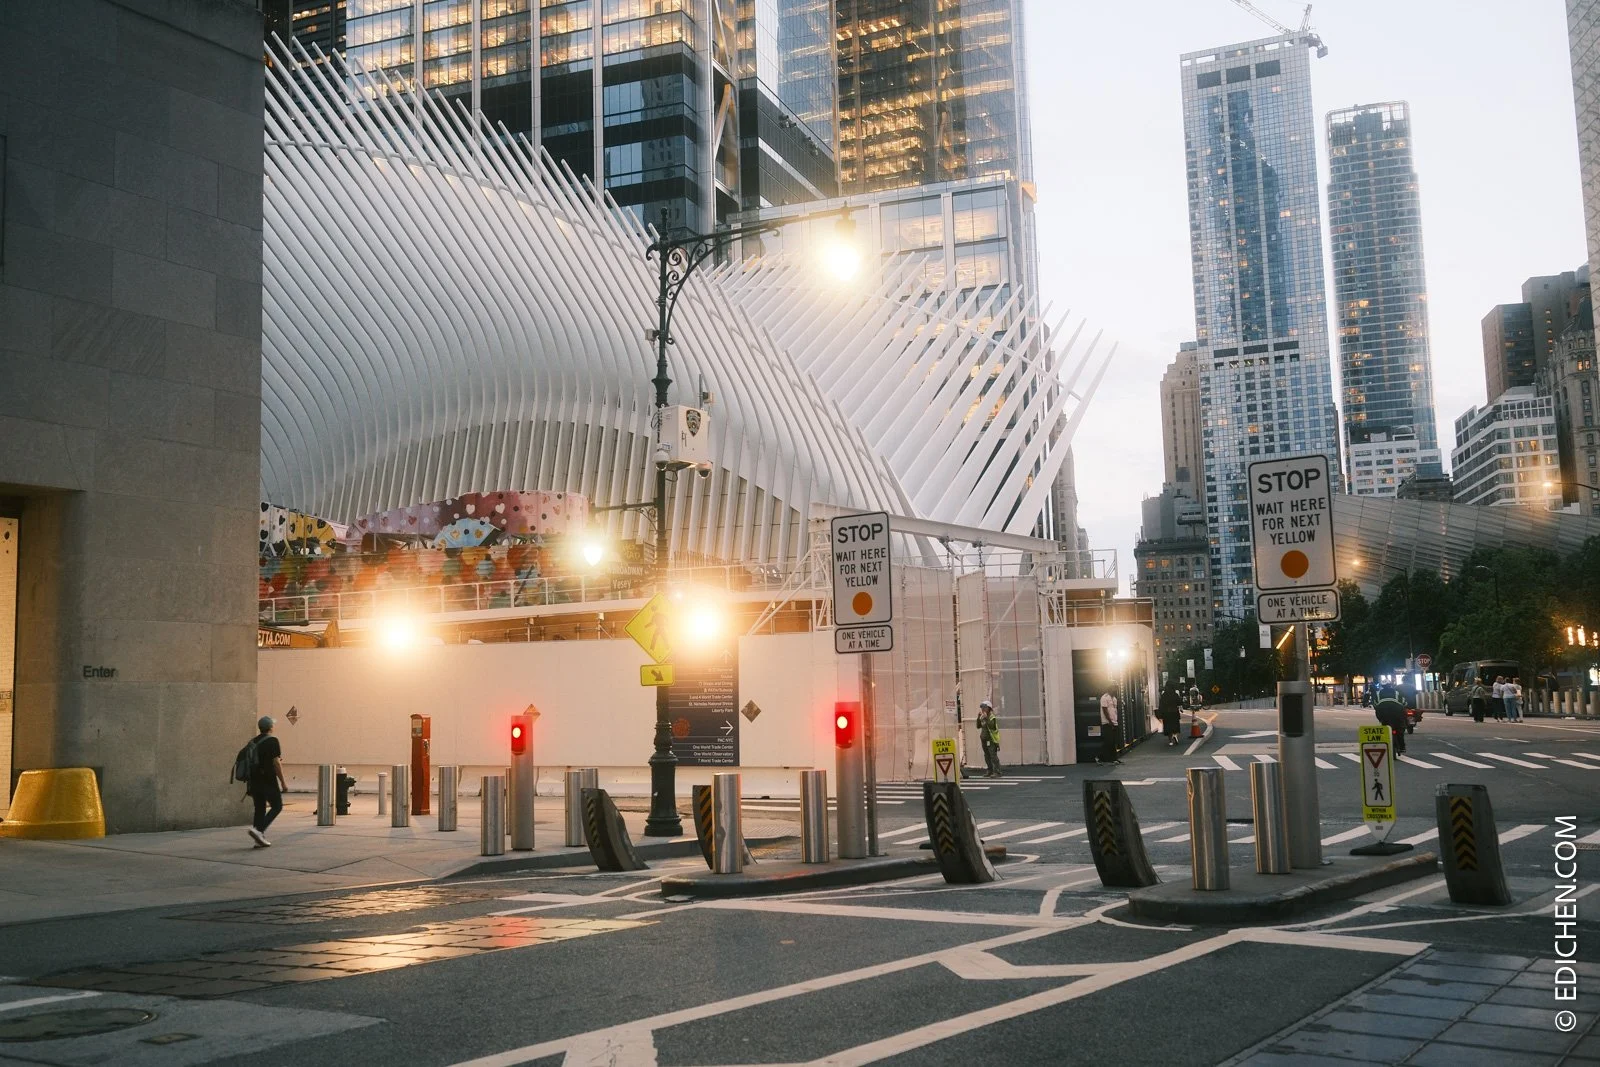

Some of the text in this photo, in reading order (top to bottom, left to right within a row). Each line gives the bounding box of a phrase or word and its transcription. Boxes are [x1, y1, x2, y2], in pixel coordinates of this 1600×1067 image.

[1258, 468, 1321, 493] STOP
[1256, 498, 1326, 516] WAIT HERE
[1263, 514, 1320, 530] FOR NEXT
[838, 523, 883, 543] STOP
[1270, 530, 1315, 545] YELLOW
[836, 548, 886, 562] WAIT HERE
[840, 561, 882, 575] FOR NEXT
[845, 575, 878, 587] YELLOW
[1268, 595, 1327, 607] ONE VEHICLE
[1277, 607, 1320, 618] AT A TIME
[842, 630, 885, 640] ONE VEHICLE
[849, 641, 857, 649] AT
[865, 640, 880, 648] TIME
[83, 666, 116, 677] Enter
